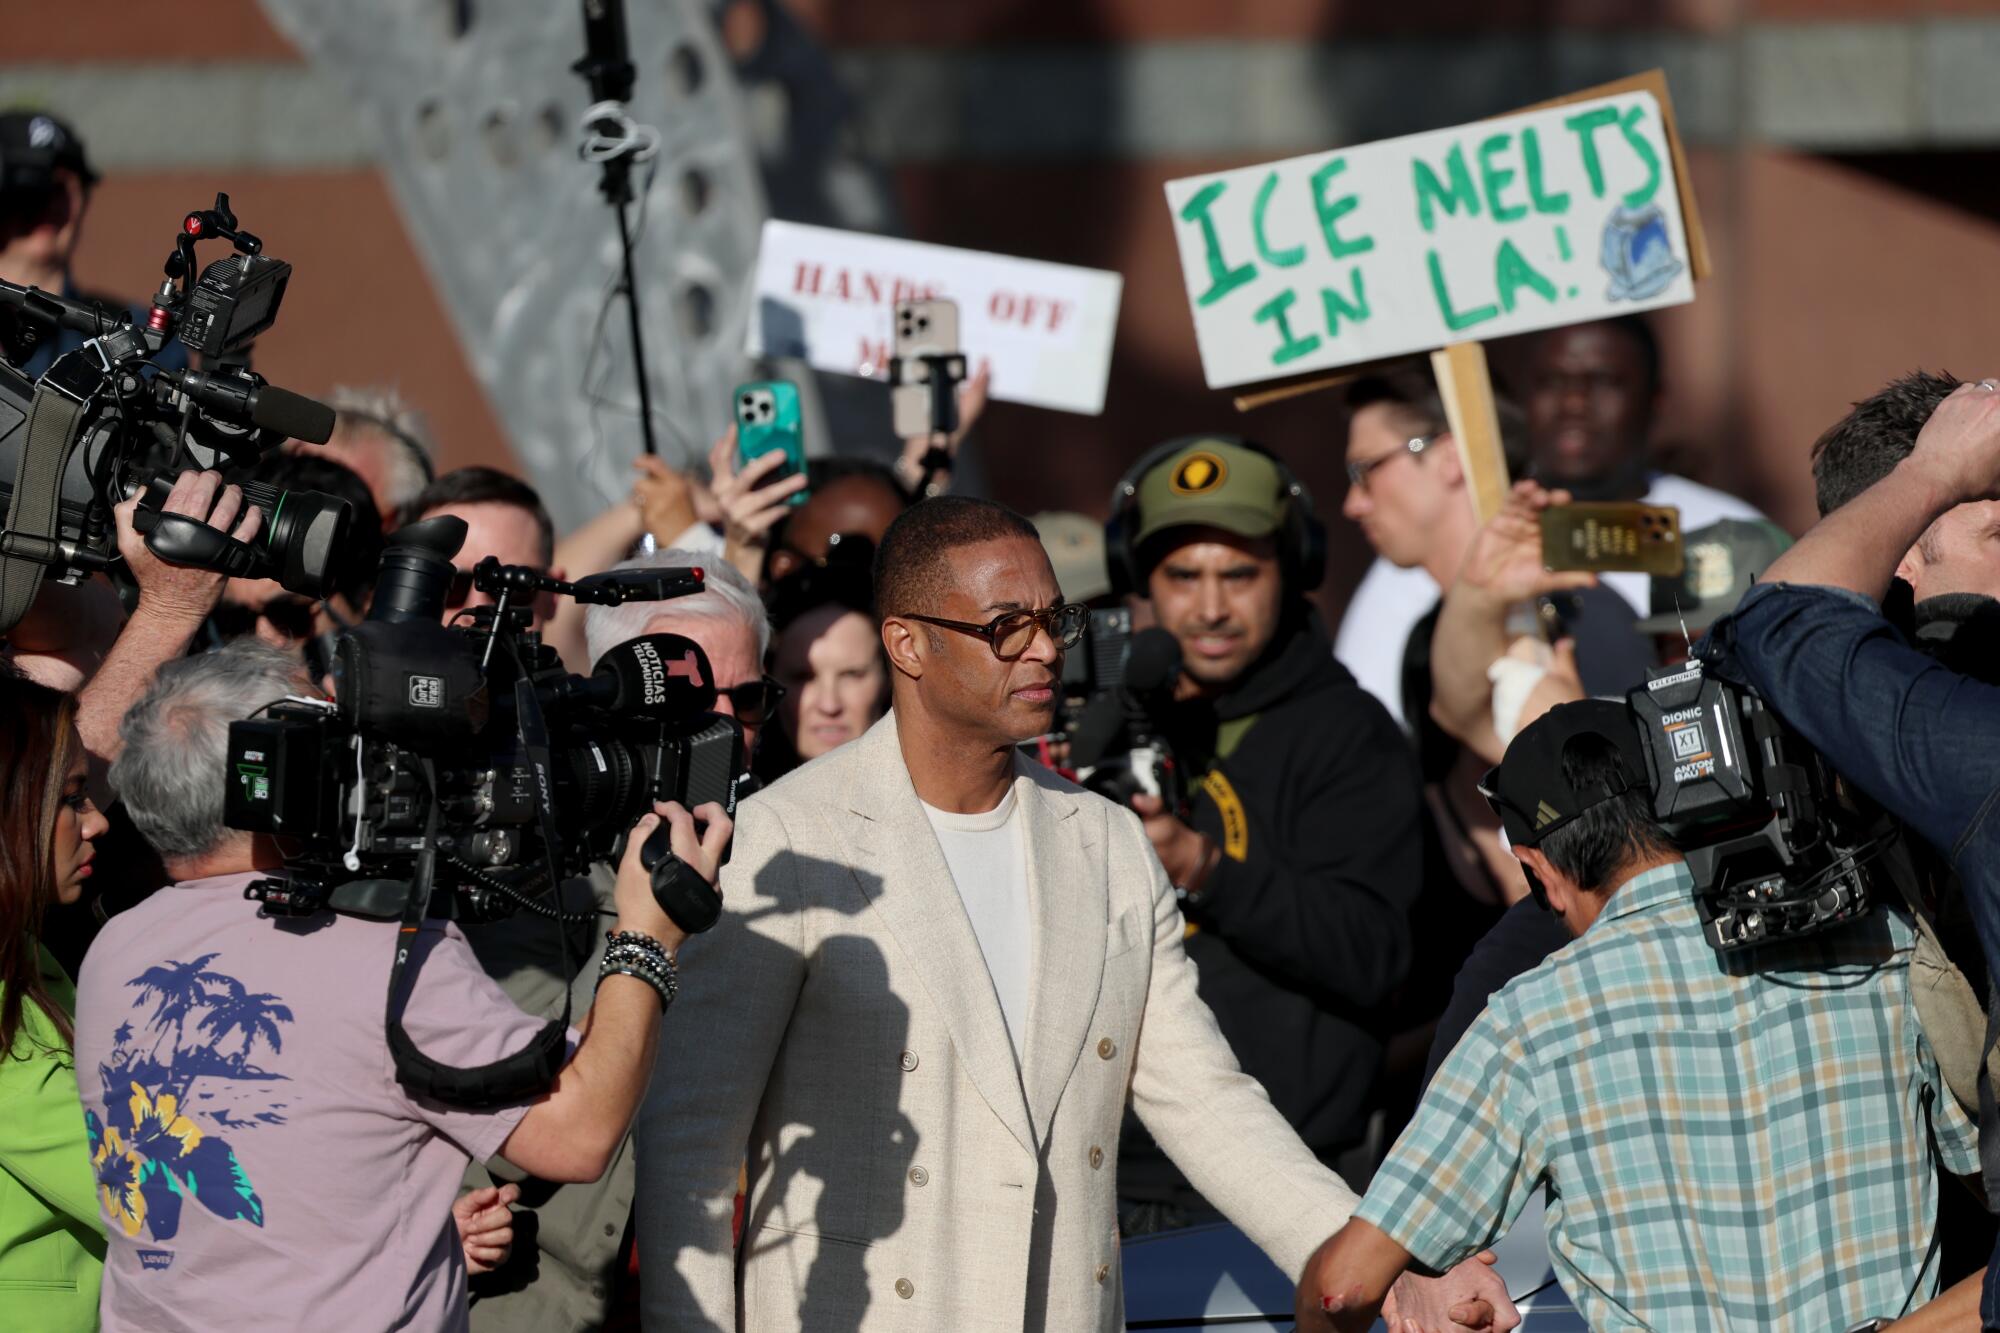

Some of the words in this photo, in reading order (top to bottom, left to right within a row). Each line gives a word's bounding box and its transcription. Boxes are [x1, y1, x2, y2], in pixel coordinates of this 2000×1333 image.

[1180, 157, 1374, 306] ICE
[1411, 104, 1661, 232] MELTS
[986, 287, 1073, 332] OFF
[1253, 266, 1372, 366] IN
[1426, 226, 1578, 332] LA!
[632, 643, 654, 705] TELEMUNDO
[641, 641, 666, 704] NOTICIAS
[1650, 669, 1701, 688] TELEMUNDO
[1662, 707, 1702, 725] DIONIC
[1679, 730, 1696, 748] XT
[535, 762, 550, 815] SONY
